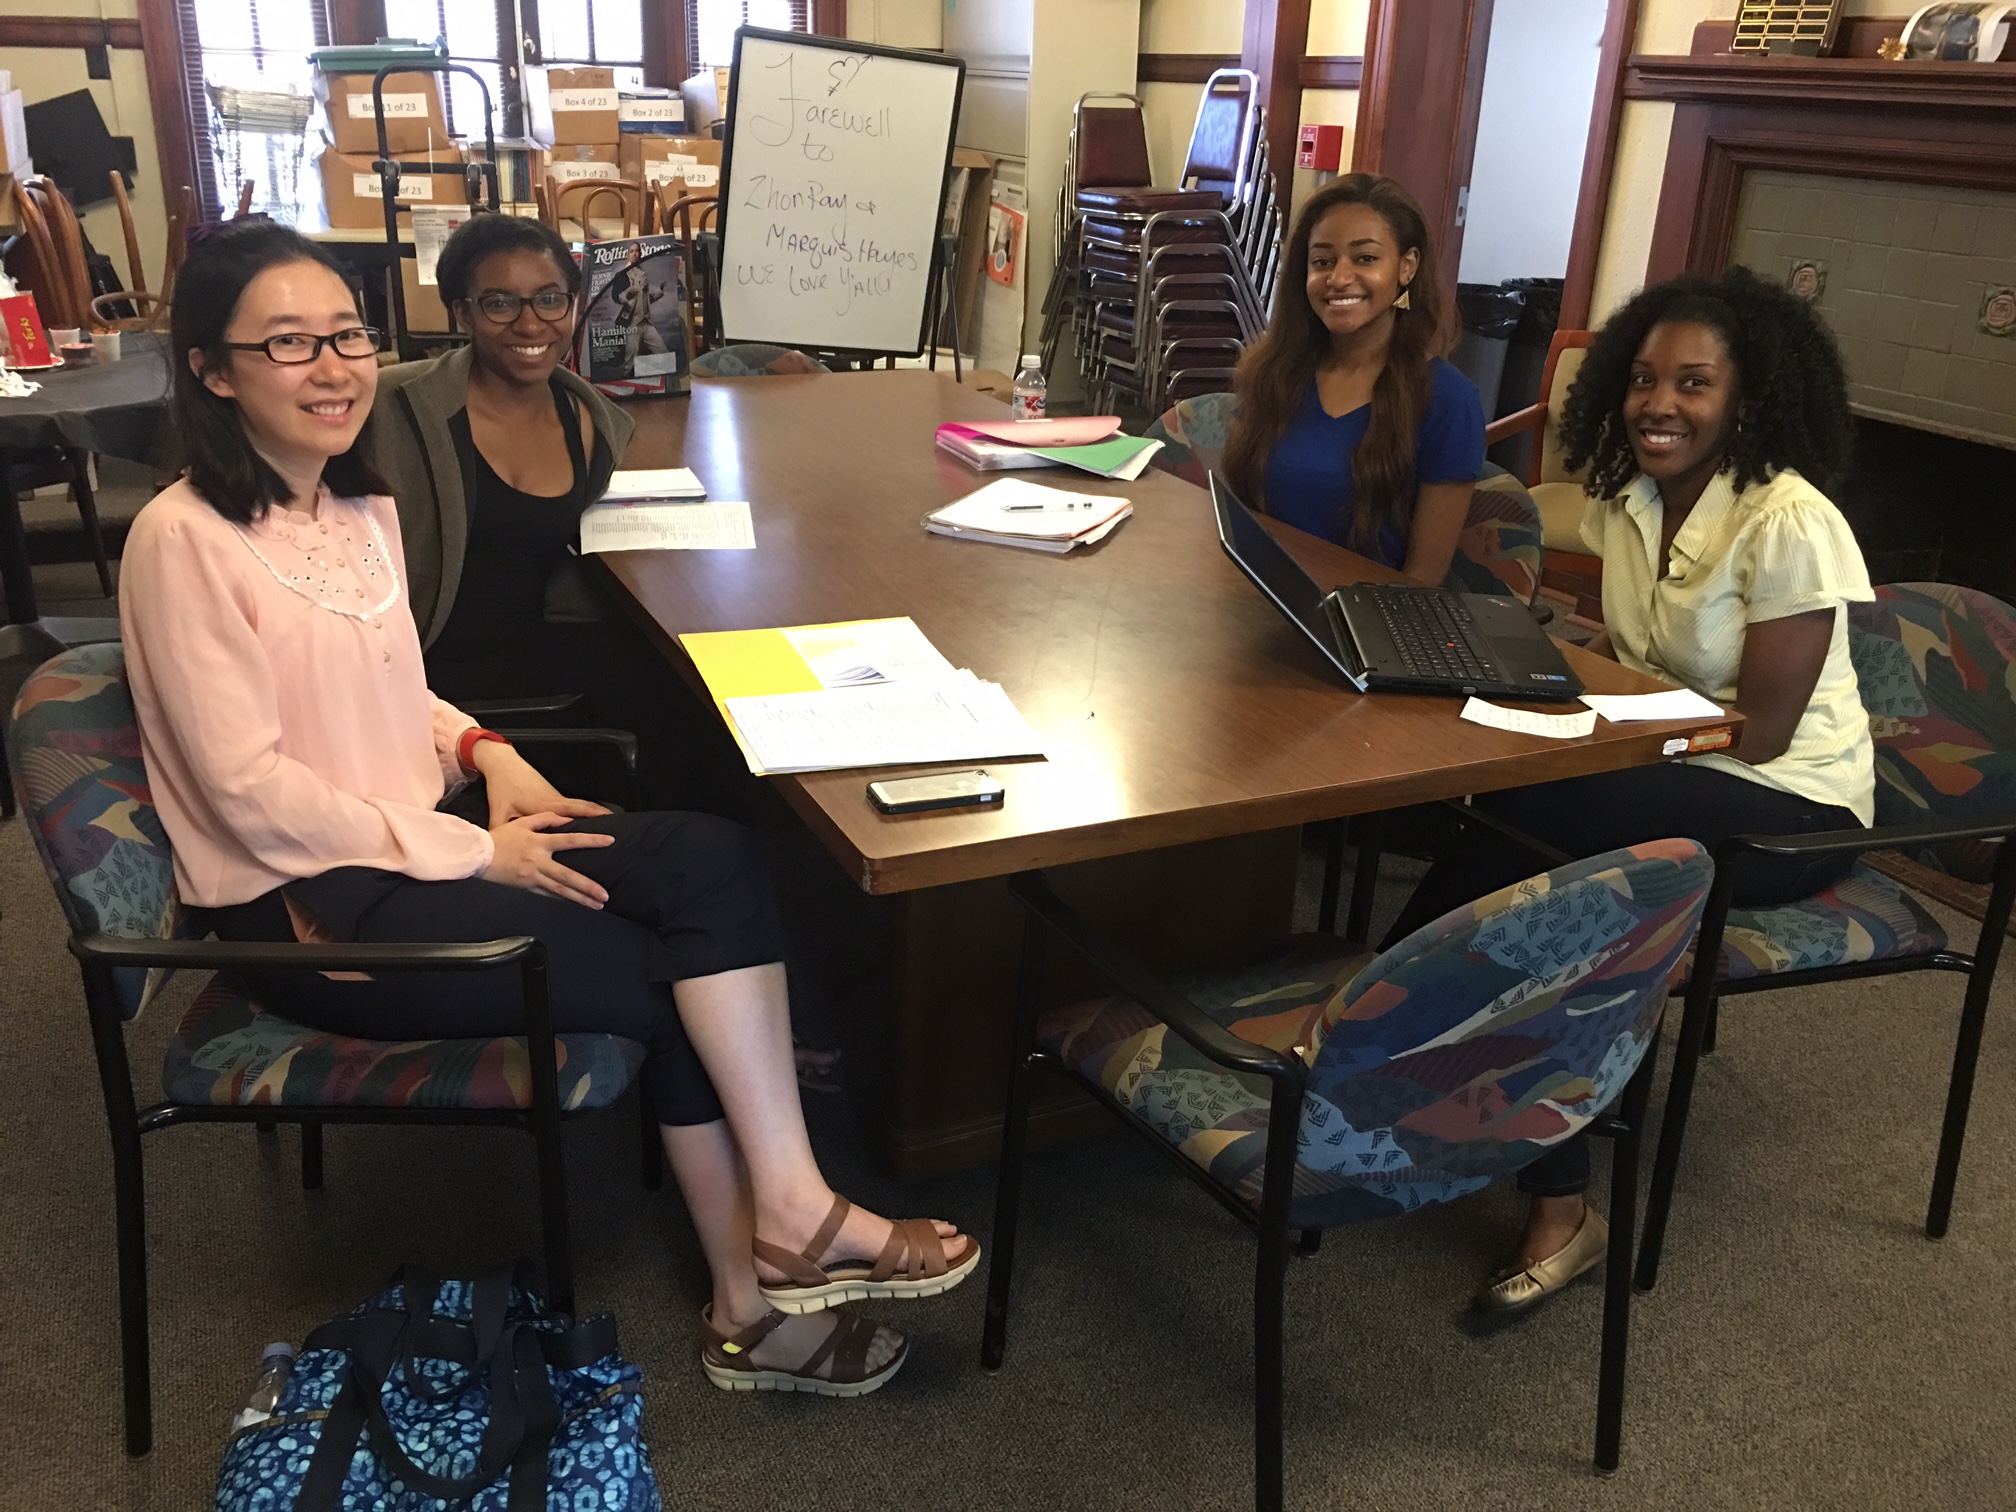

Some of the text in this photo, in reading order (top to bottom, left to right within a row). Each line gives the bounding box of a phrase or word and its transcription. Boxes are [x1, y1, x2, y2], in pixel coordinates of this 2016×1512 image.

[565, 98, 579, 106] Box
[588, 98, 597, 106] of
[598, 98, 607, 106] 23
[362, 103, 374, 112] Bo
[394, 103, 403, 112] of
[405, 103, 416, 112] 23
[632, 108, 646, 116] Box
[655, 108, 664, 116] of
[801, 132, 834, 162] to
[566, 169, 581, 177] Box
[589, 170, 598, 178] of
[599, 170, 608, 178] 23
[686, 173, 695, 182] of
[696, 174, 706, 182] 23
[400, 185, 409, 194] of
[411, 186, 421, 195] 23
[594, 246, 629, 265] Rollin
[858, 238, 917, 286] Hayes
[591, 324, 638, 337] Hamilton
[591, 334, 627, 348] Mania!
